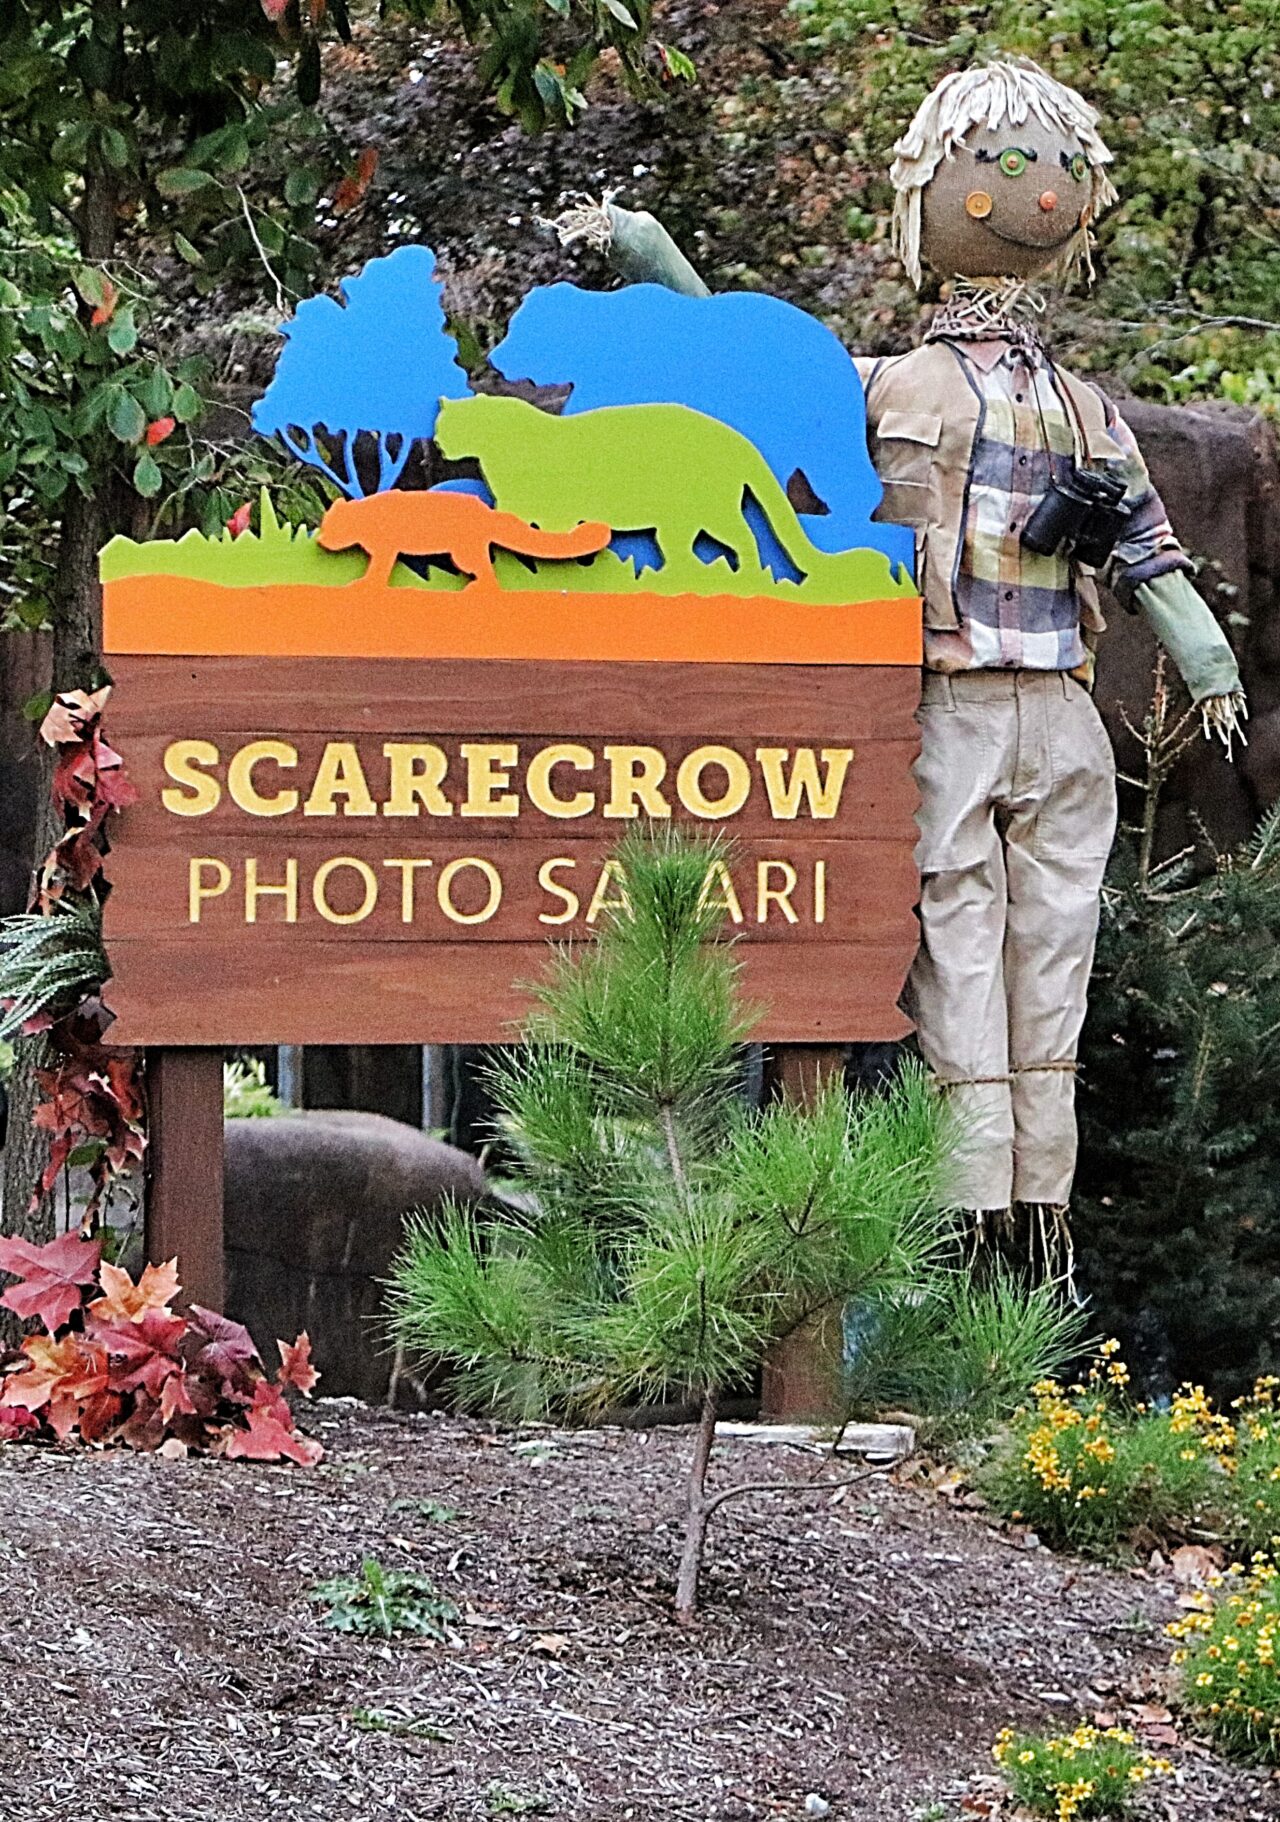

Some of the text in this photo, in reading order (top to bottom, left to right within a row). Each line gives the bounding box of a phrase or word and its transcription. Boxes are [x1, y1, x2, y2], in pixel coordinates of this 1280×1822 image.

[160, 739, 855, 819] SCARECROW
[188, 857, 826, 925] PHOTO SAARI
